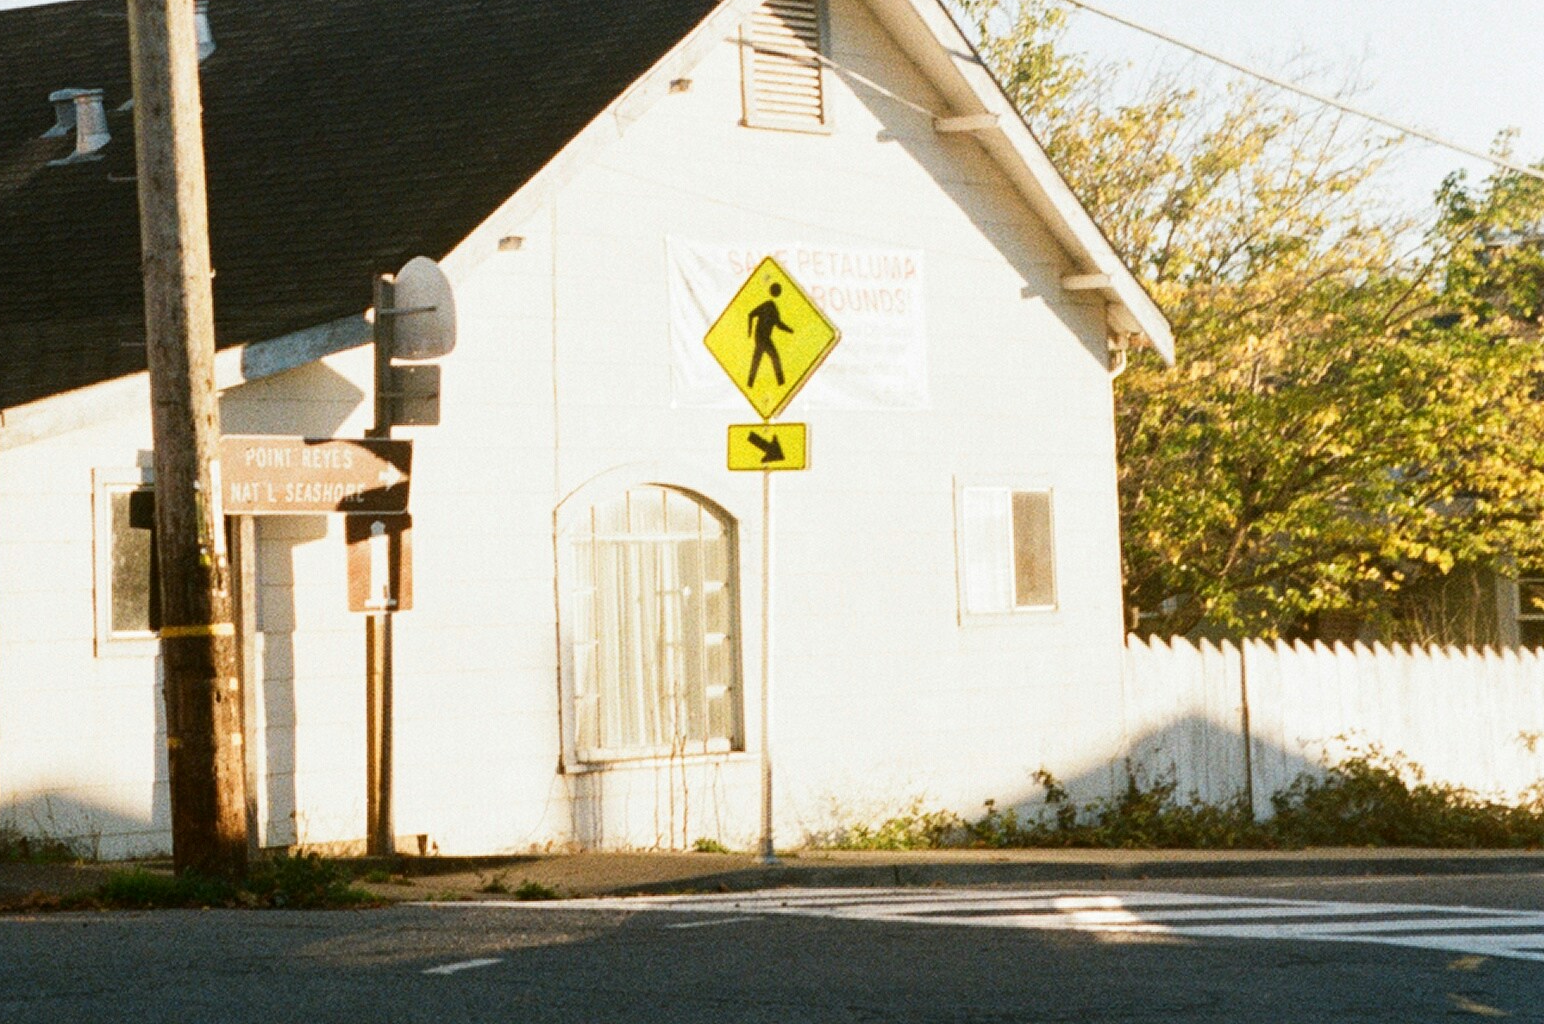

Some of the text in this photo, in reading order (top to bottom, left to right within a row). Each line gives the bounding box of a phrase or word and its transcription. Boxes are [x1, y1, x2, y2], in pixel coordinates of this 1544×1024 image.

[727, 249, 788, 276] SAE
[245, 447, 353, 470] POINT REYES
[285, 482, 366, 503] SEASHORE
